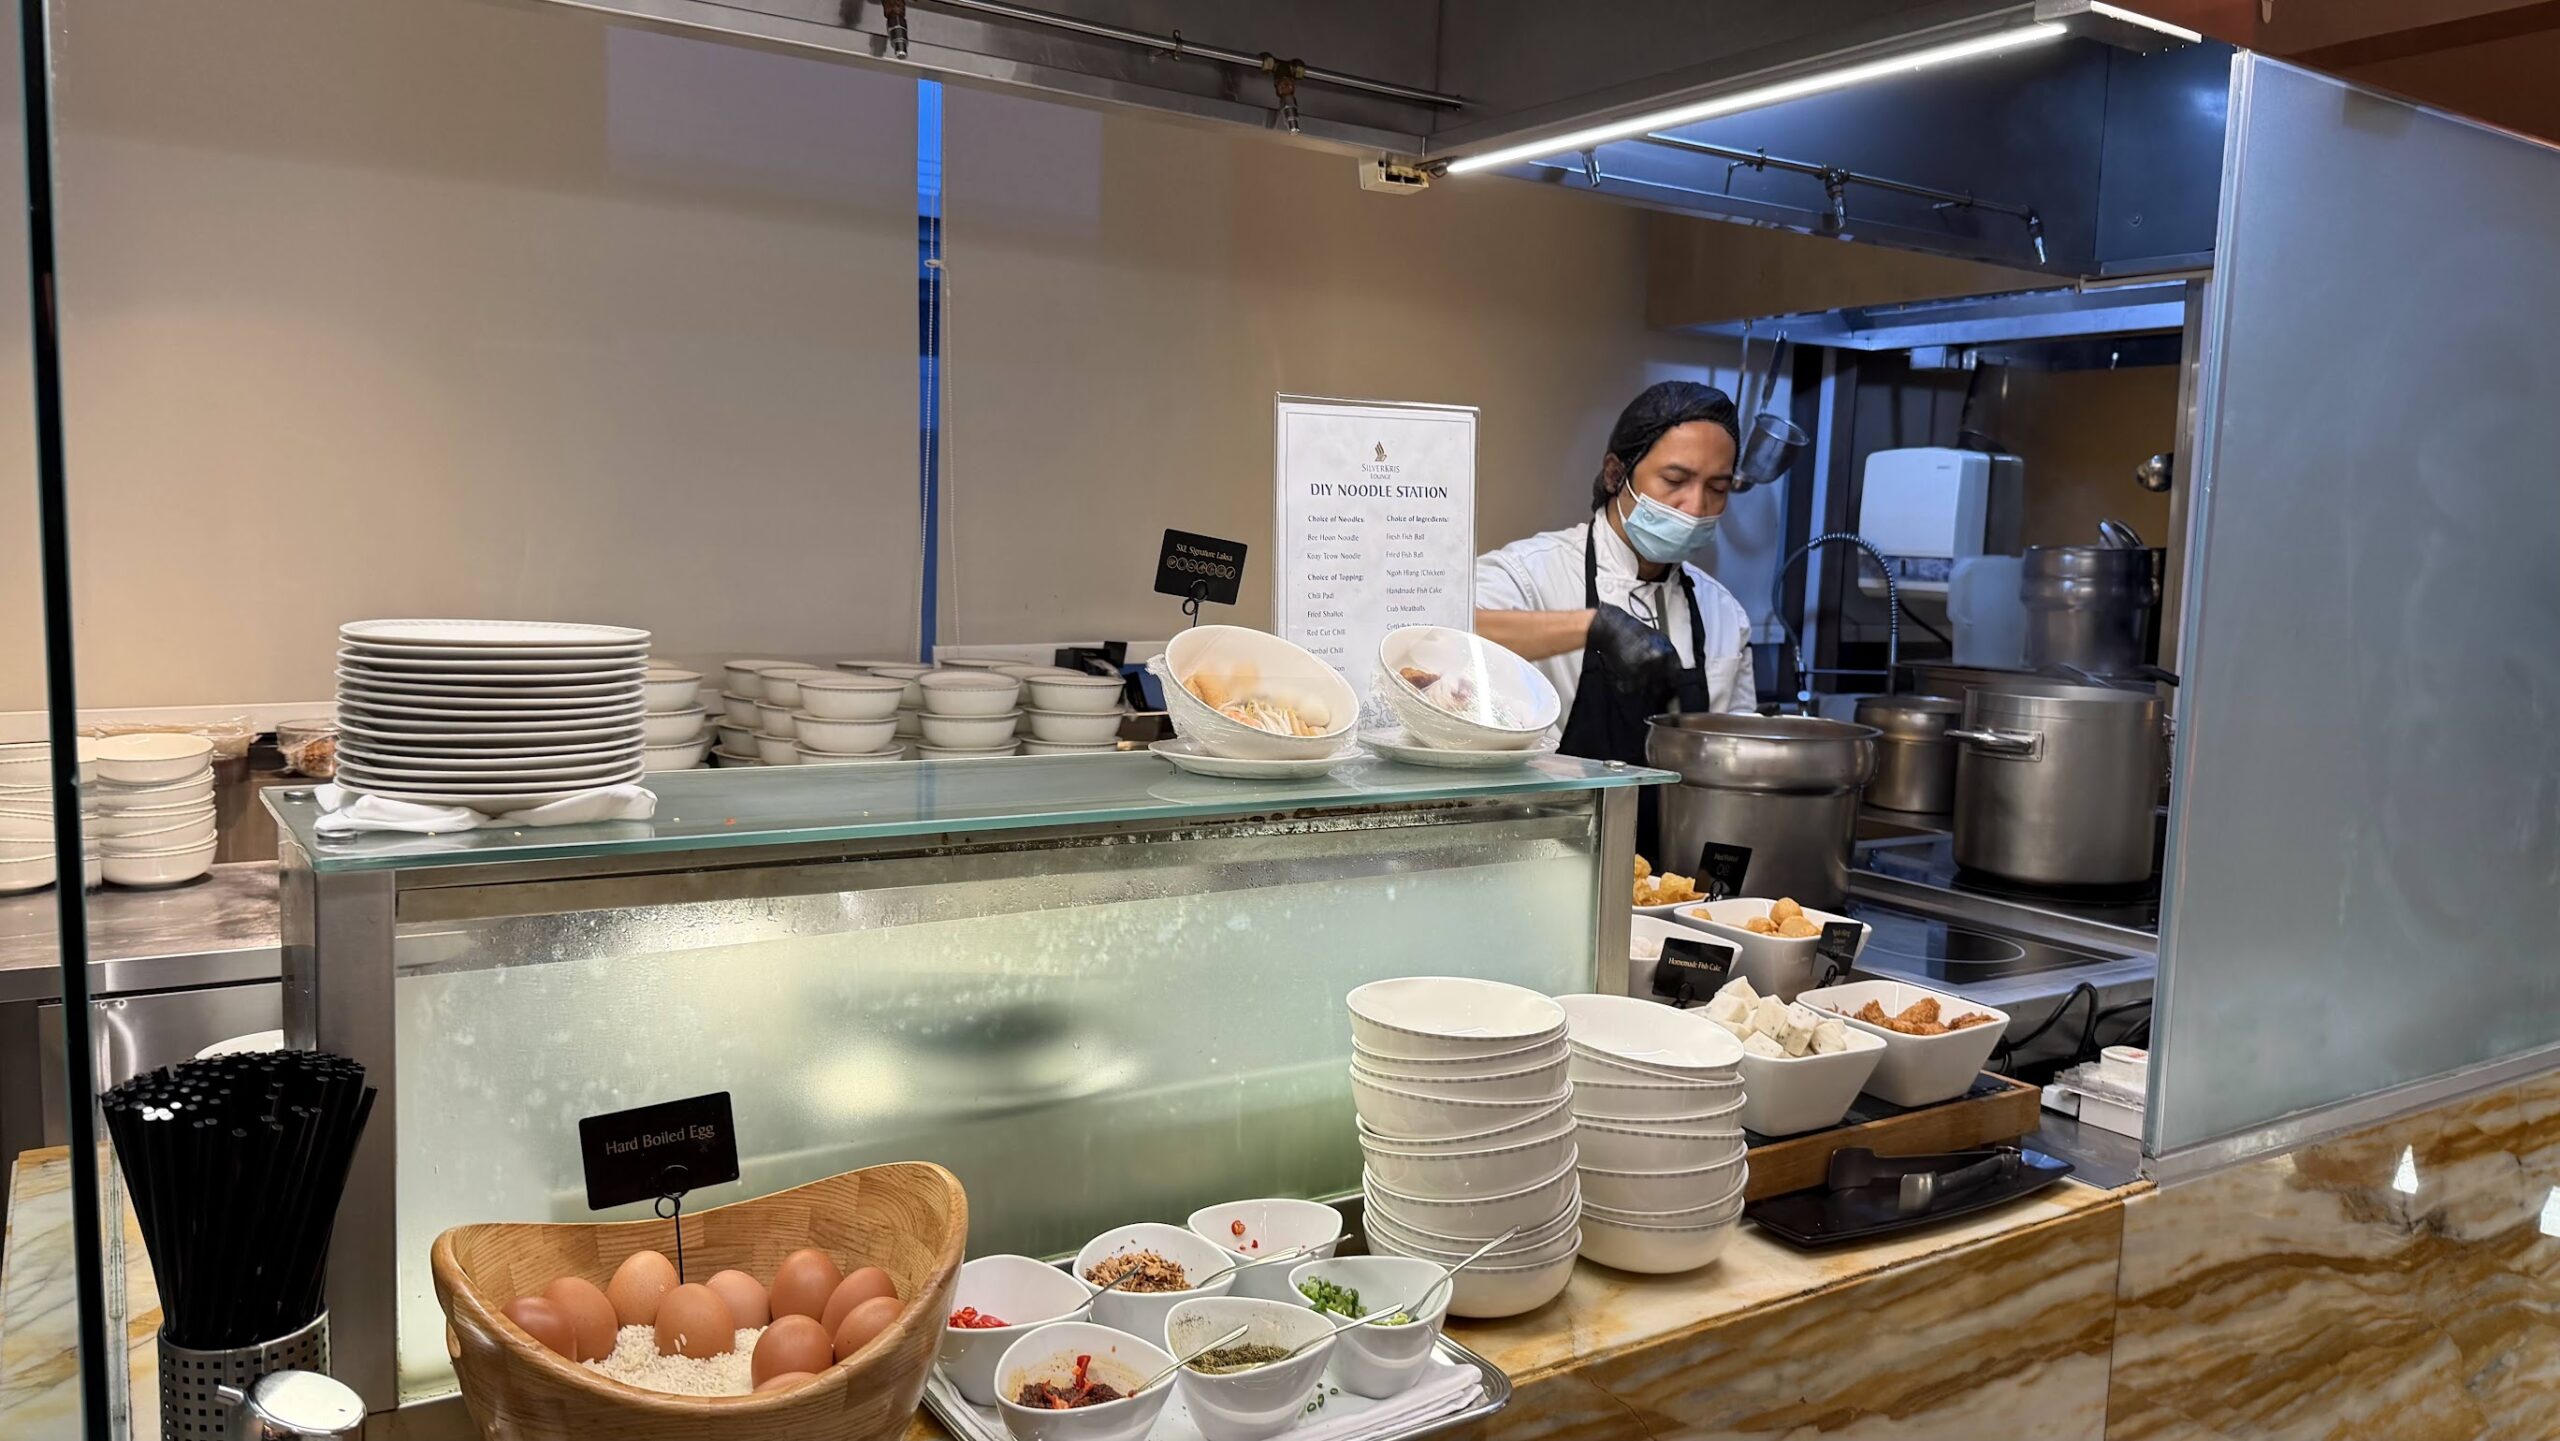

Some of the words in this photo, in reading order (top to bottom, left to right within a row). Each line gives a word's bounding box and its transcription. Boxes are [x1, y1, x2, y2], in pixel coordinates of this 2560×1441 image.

[1310, 484, 1333, 496] DIY
[1338, 484, 1392, 497] NOODLE
[1396, 485, 1448, 498] STATION
[1668, 957, 1697, 968] Homemade
[1698, 961, 1709, 970] Fish
[1709, 963, 1722, 972] Cake
[605, 1137, 638, 1155] Hard
[643, 1128, 685, 1148] Boiled
[690, 1124, 716, 1140] Egg
